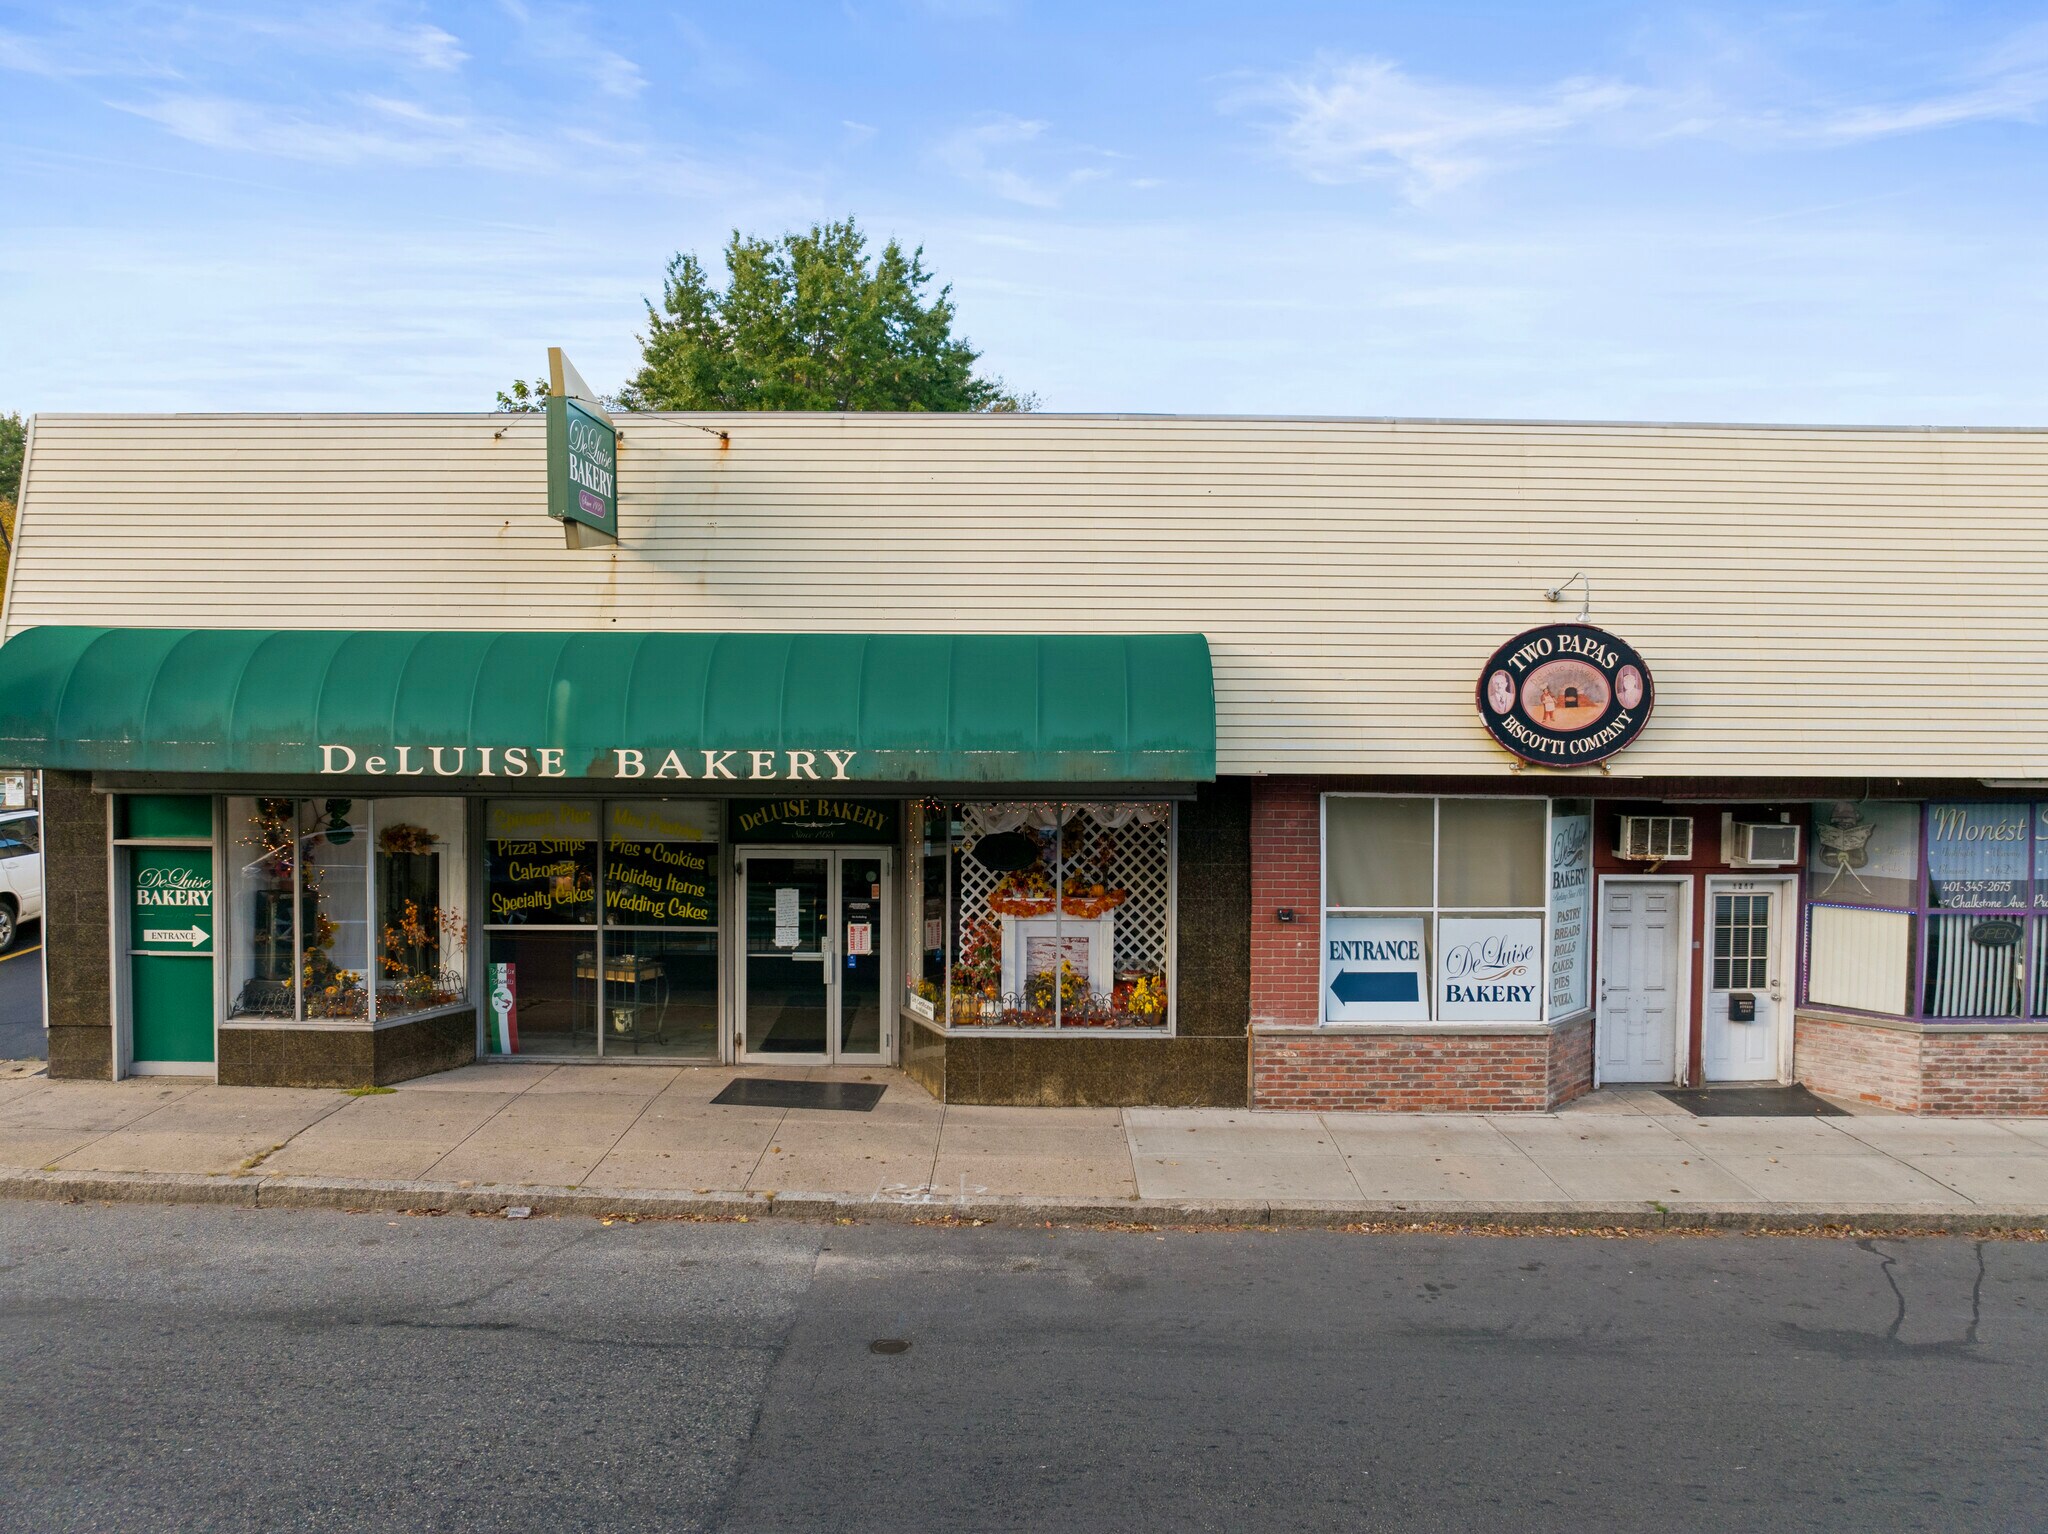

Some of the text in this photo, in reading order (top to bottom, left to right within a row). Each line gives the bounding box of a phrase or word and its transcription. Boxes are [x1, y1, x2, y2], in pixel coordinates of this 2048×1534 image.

[569, 453, 613, 498] BAKERY
[1508, 634, 1619, 673] TWO PAPAS
[1501, 709, 1633, 755] BISCOTTI COMPANY
[319, 745, 858, 781] DeLUISE BAKERY
[739, 799, 889, 832] DeLUISE BAKERY
[1935, 807, 2027, 841] Monést
[497, 834, 586, 857] Pizza Strips
[609, 833, 705, 871] Pies Cookies
[608, 863, 706, 898] Holiday Items
[1552, 867, 1587, 890] BAKERY
[1942, 881, 2012, 892] 401-345-2675
[137, 889, 213, 906] BAKERY
[491, 882, 595, 916] Specialty Cakes
[606, 889, 709, 921] Wedding Cakes
[1951, 893, 2002, 909] Chalkstone
[2003, 894, 2028, 909] Ave.
[1556, 907, 1582, 924] PASTRY
[151, 932, 197, 940] ENTRANCE
[1554, 924, 1581, 941] BREADS
[1974, 927, 2018, 939] OPEN
[1329, 940, 1420, 962] ENTRANCE
[1553, 941, 1577, 958] ROLLS
[1552, 958, 1574, 974] CAKES
[1553, 974, 1570, 991] PIES
[1446, 985, 1537, 1003] BAKERY
[1552, 992, 1574, 1008] PIZZA
